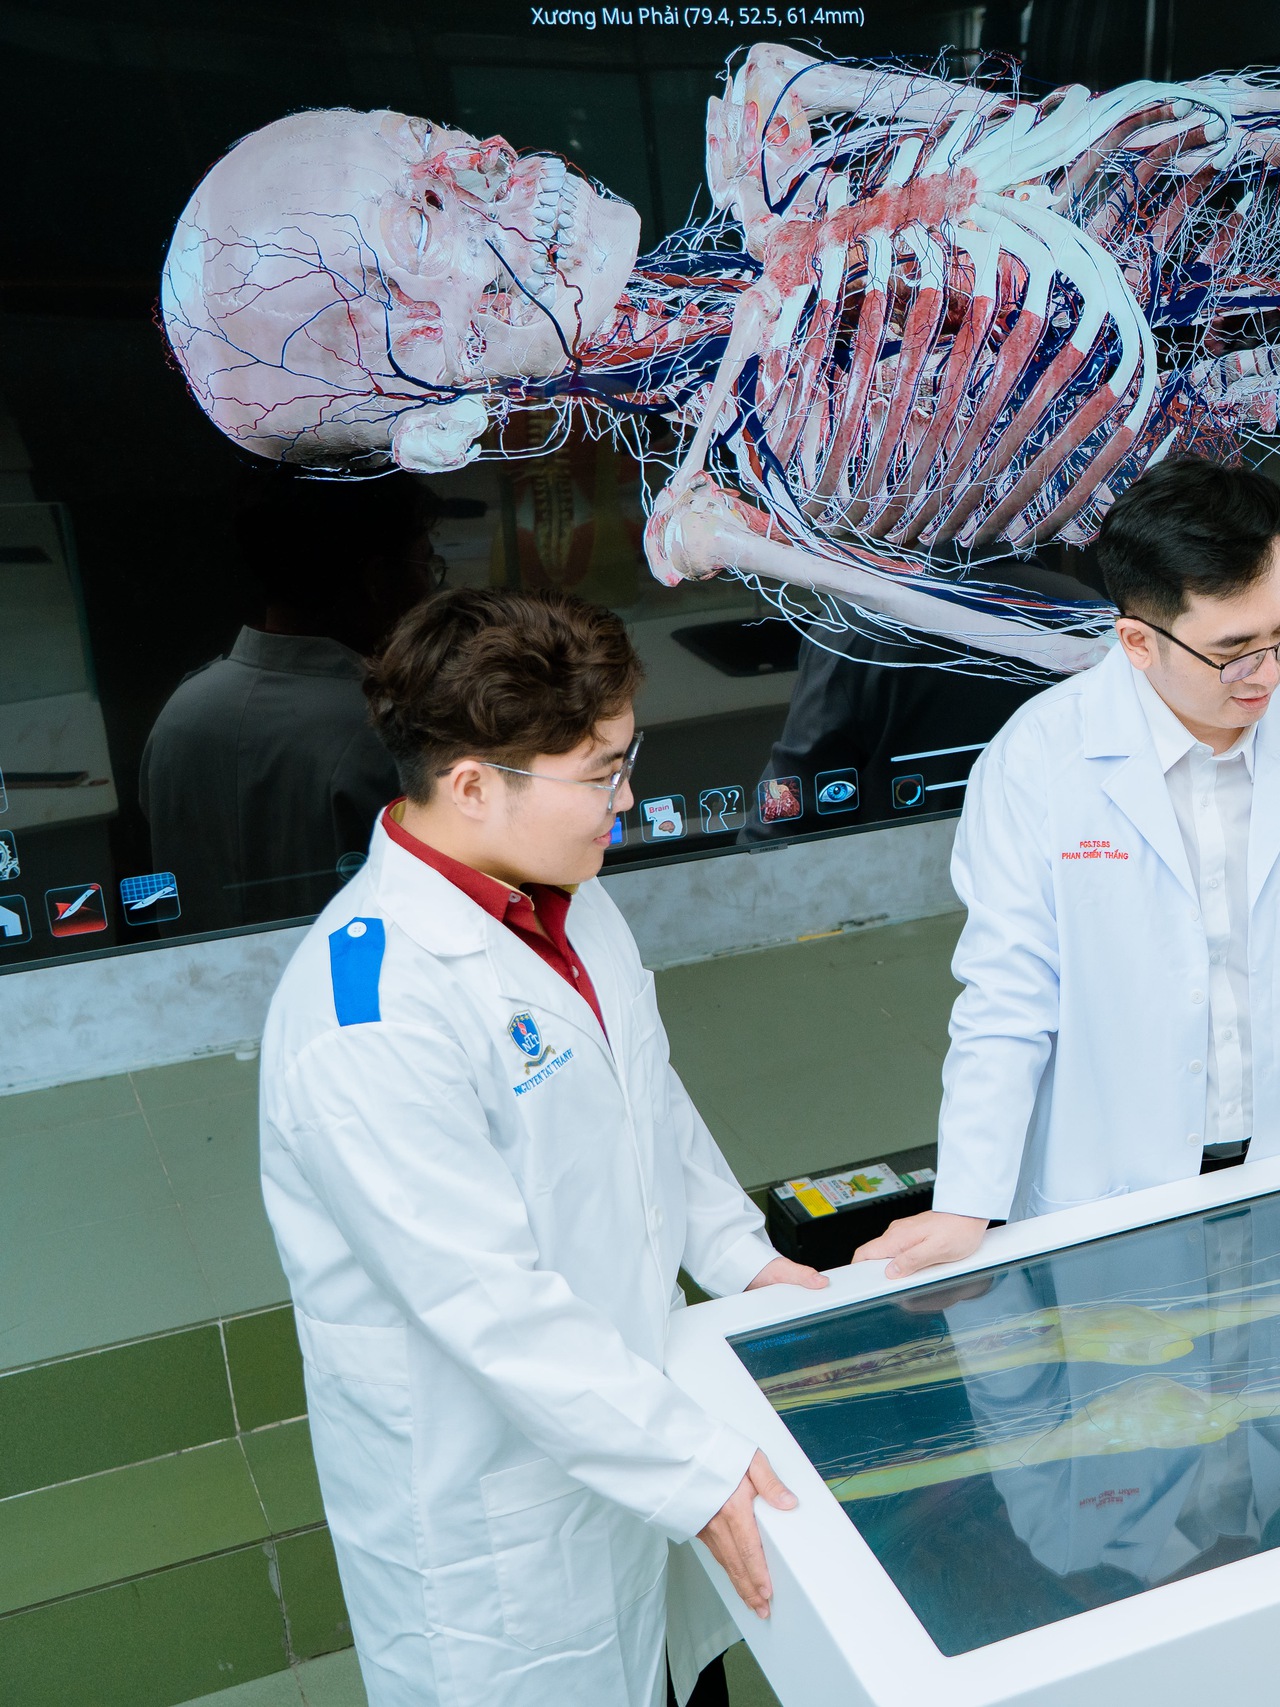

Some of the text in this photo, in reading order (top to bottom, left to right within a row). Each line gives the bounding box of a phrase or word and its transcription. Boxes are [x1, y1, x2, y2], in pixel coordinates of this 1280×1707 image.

[531, 5, 865, 30] Xương Mu Phải (79.4, 52.5, 61.4mm)
[649, 804, 670, 814] Brain
[1062, 852, 1081, 860] PHAN
